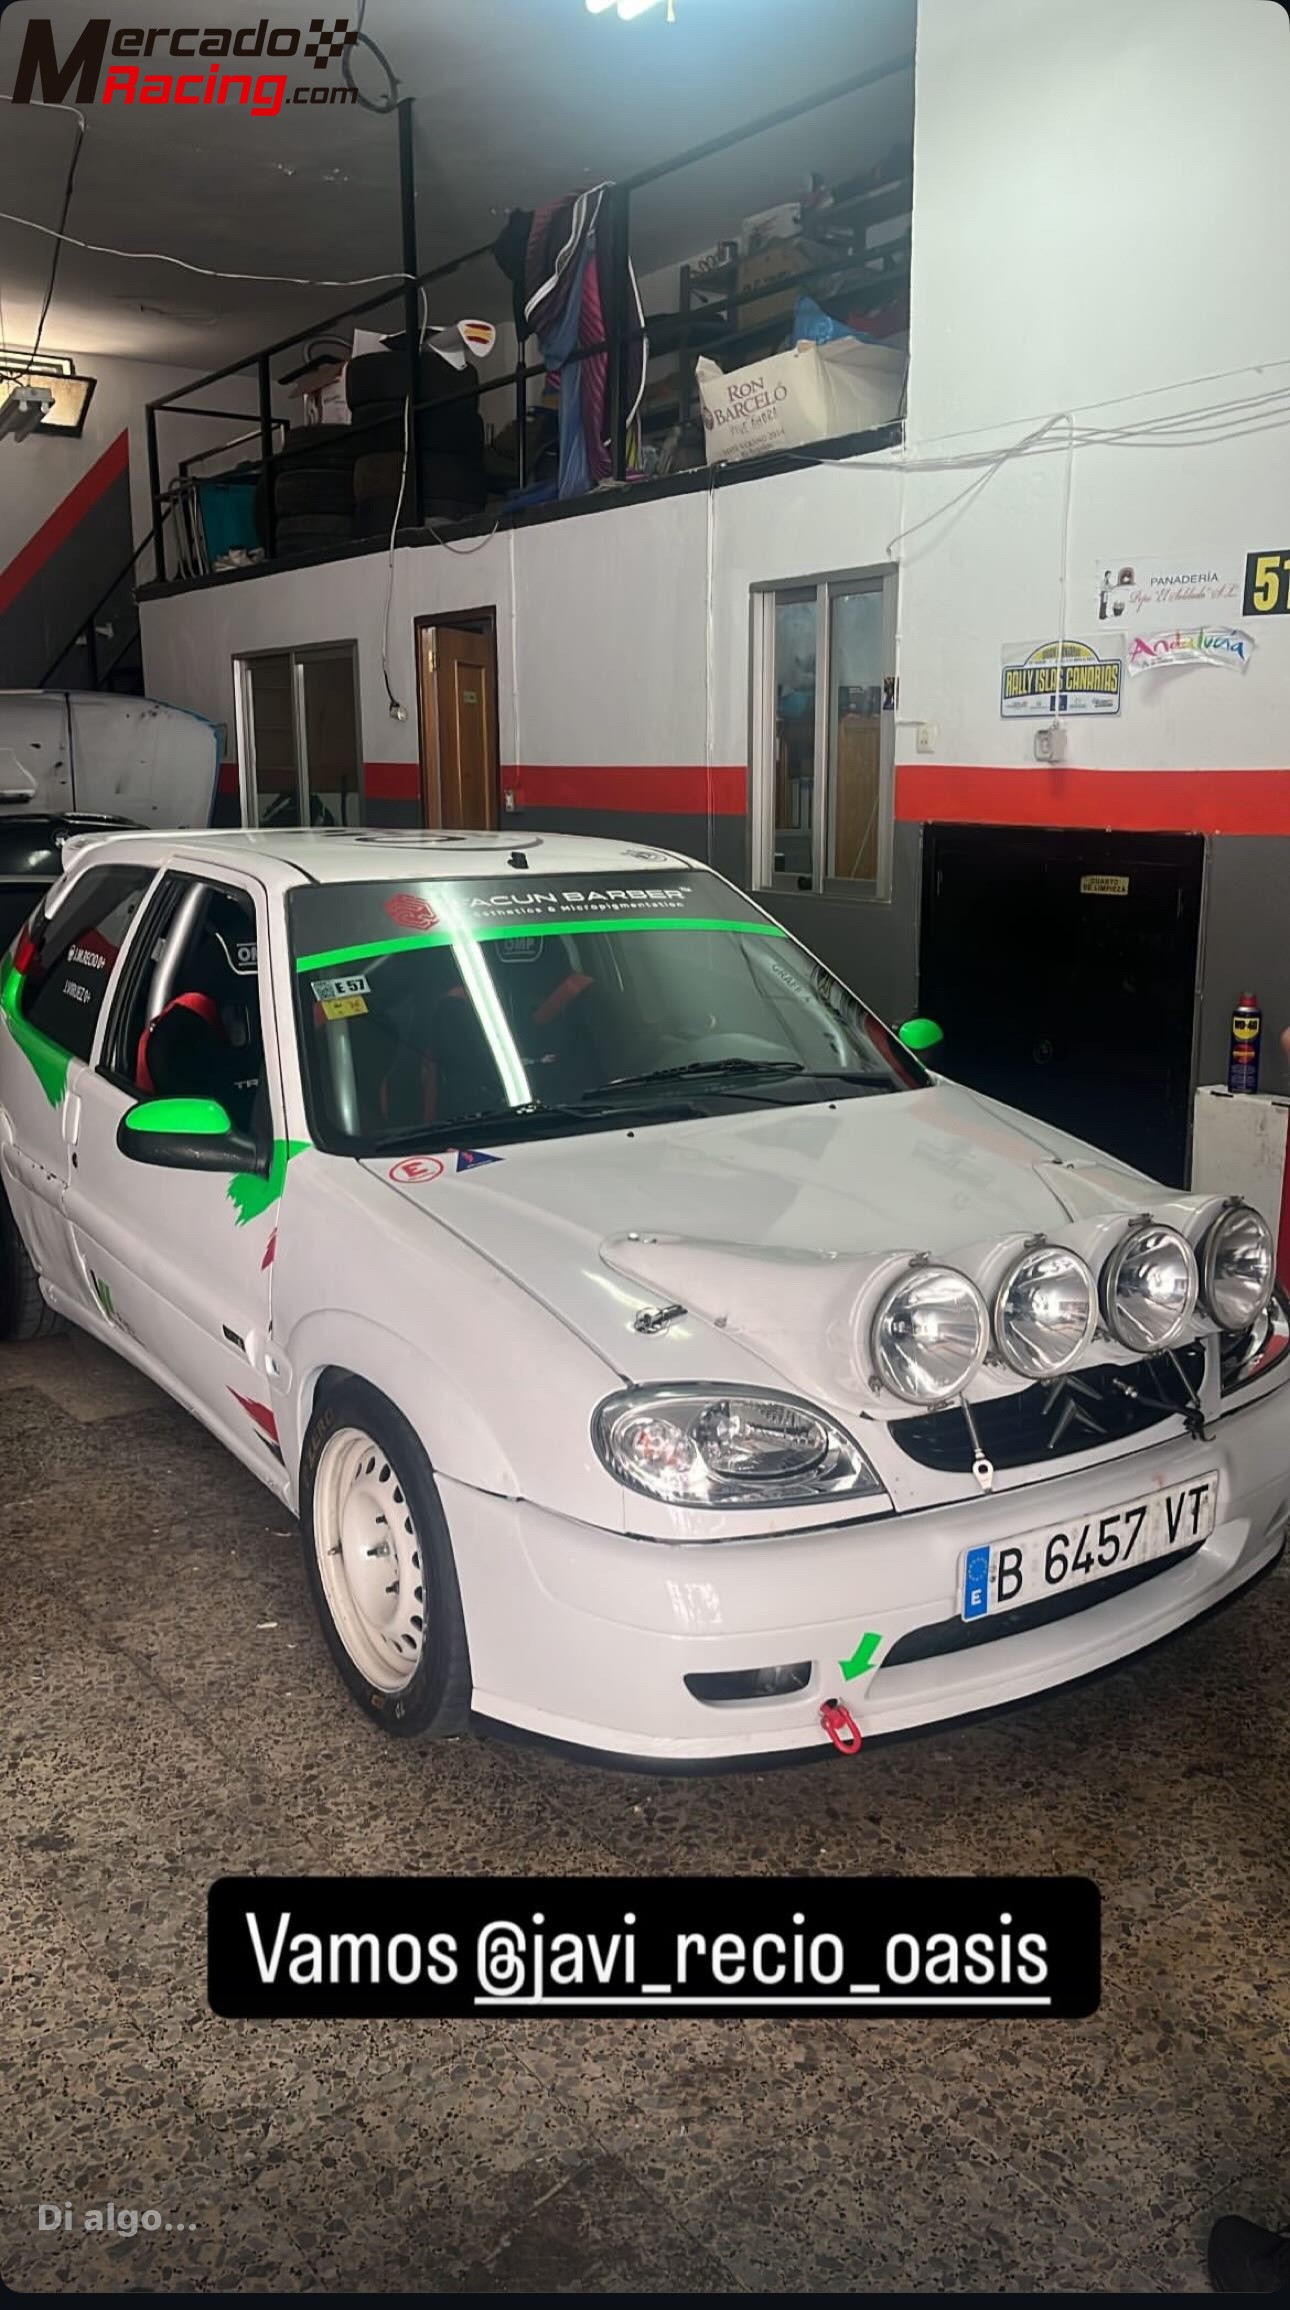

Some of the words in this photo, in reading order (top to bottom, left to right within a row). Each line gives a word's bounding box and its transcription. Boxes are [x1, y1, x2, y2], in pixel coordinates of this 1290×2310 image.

[727, 377, 765, 401] RON
[713, 381, 787, 425] BARCELÓ
[1150, 572, 1219, 587] PANADERÍA
[1128, 628, 1245, 661] Andalucía
[1006, 670, 1034, 698] RALLY
[1035, 669, 1063, 691] ISLAS
[1065, 665, 1119, 692] CANARIAS
[560, 901, 685, 912] Micropigmentation
[334, 982, 346, 994] E
[346, 978, 365, 992] 57
[402, 1161, 429, 1178] E
[997, 1547, 1024, 1603] B
[1045, 1504, 1148, 1585] 6457
[1165, 1484, 1210, 1545] VT
[971, 1589, 983, 1606] E
